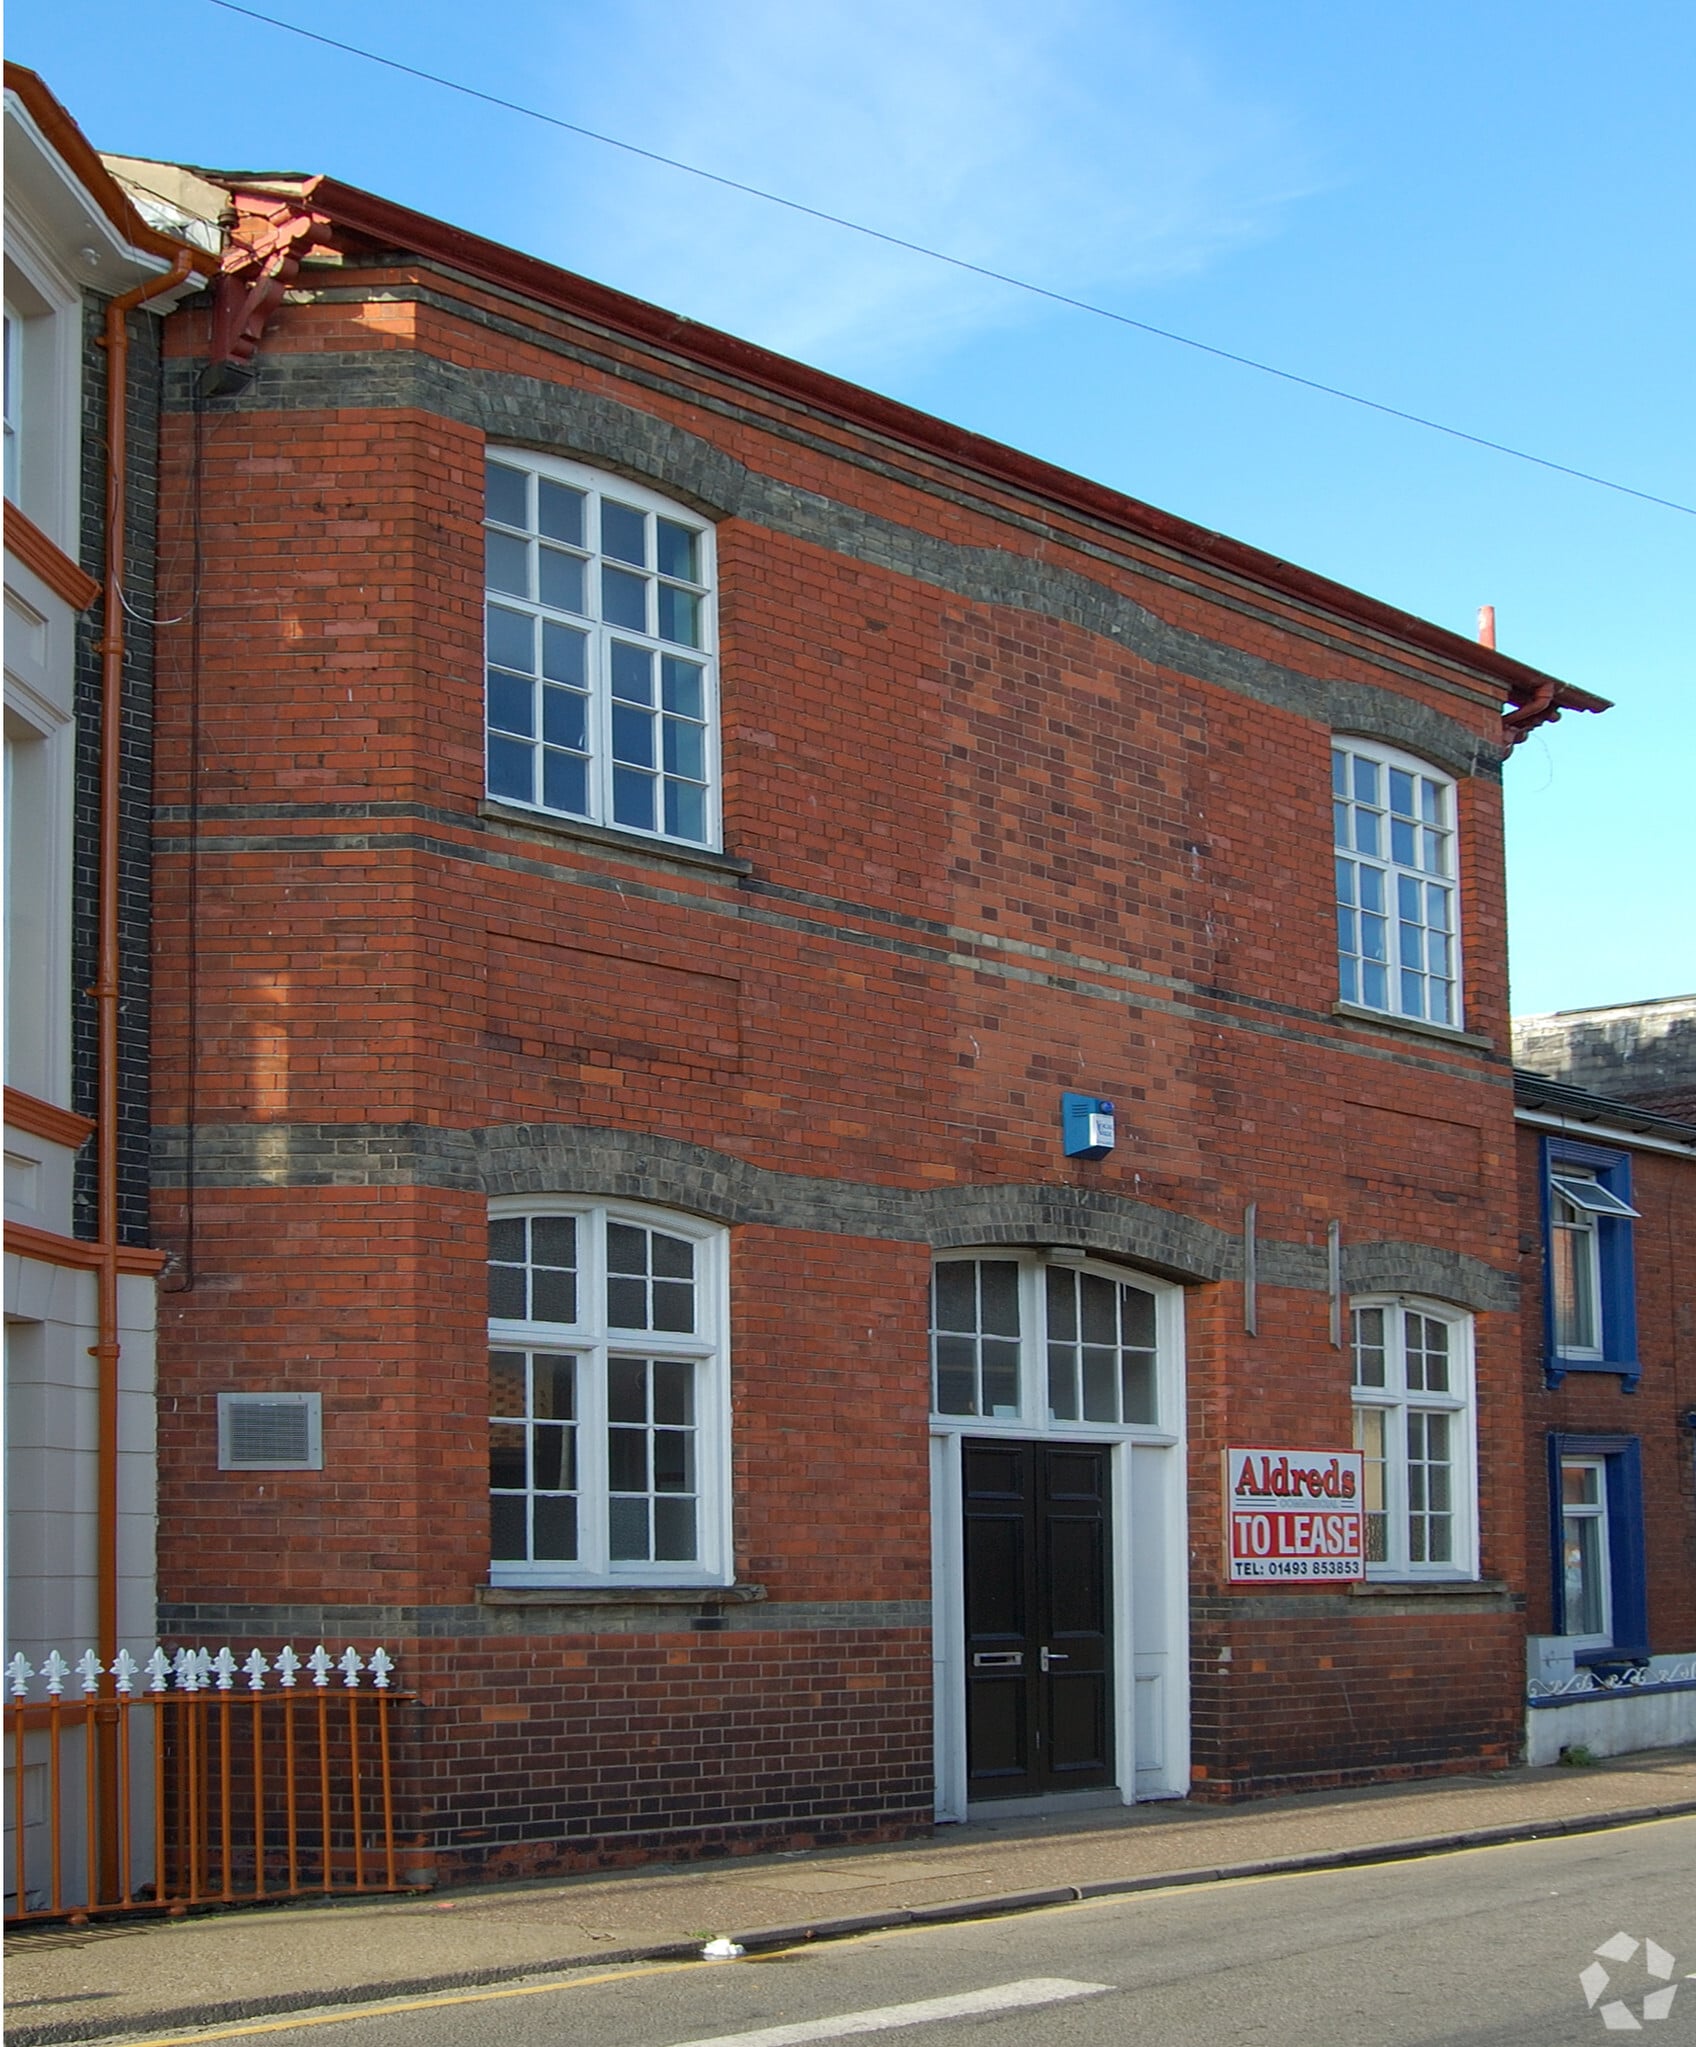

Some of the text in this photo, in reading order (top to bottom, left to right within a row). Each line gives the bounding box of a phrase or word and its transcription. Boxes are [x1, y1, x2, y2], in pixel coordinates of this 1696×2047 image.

[1235, 1456, 1355, 1498] Aldreds
[1235, 1515, 1358, 1555] TO LEASE
[1235, 1561, 1360, 1575] TEL: 01493 853853
